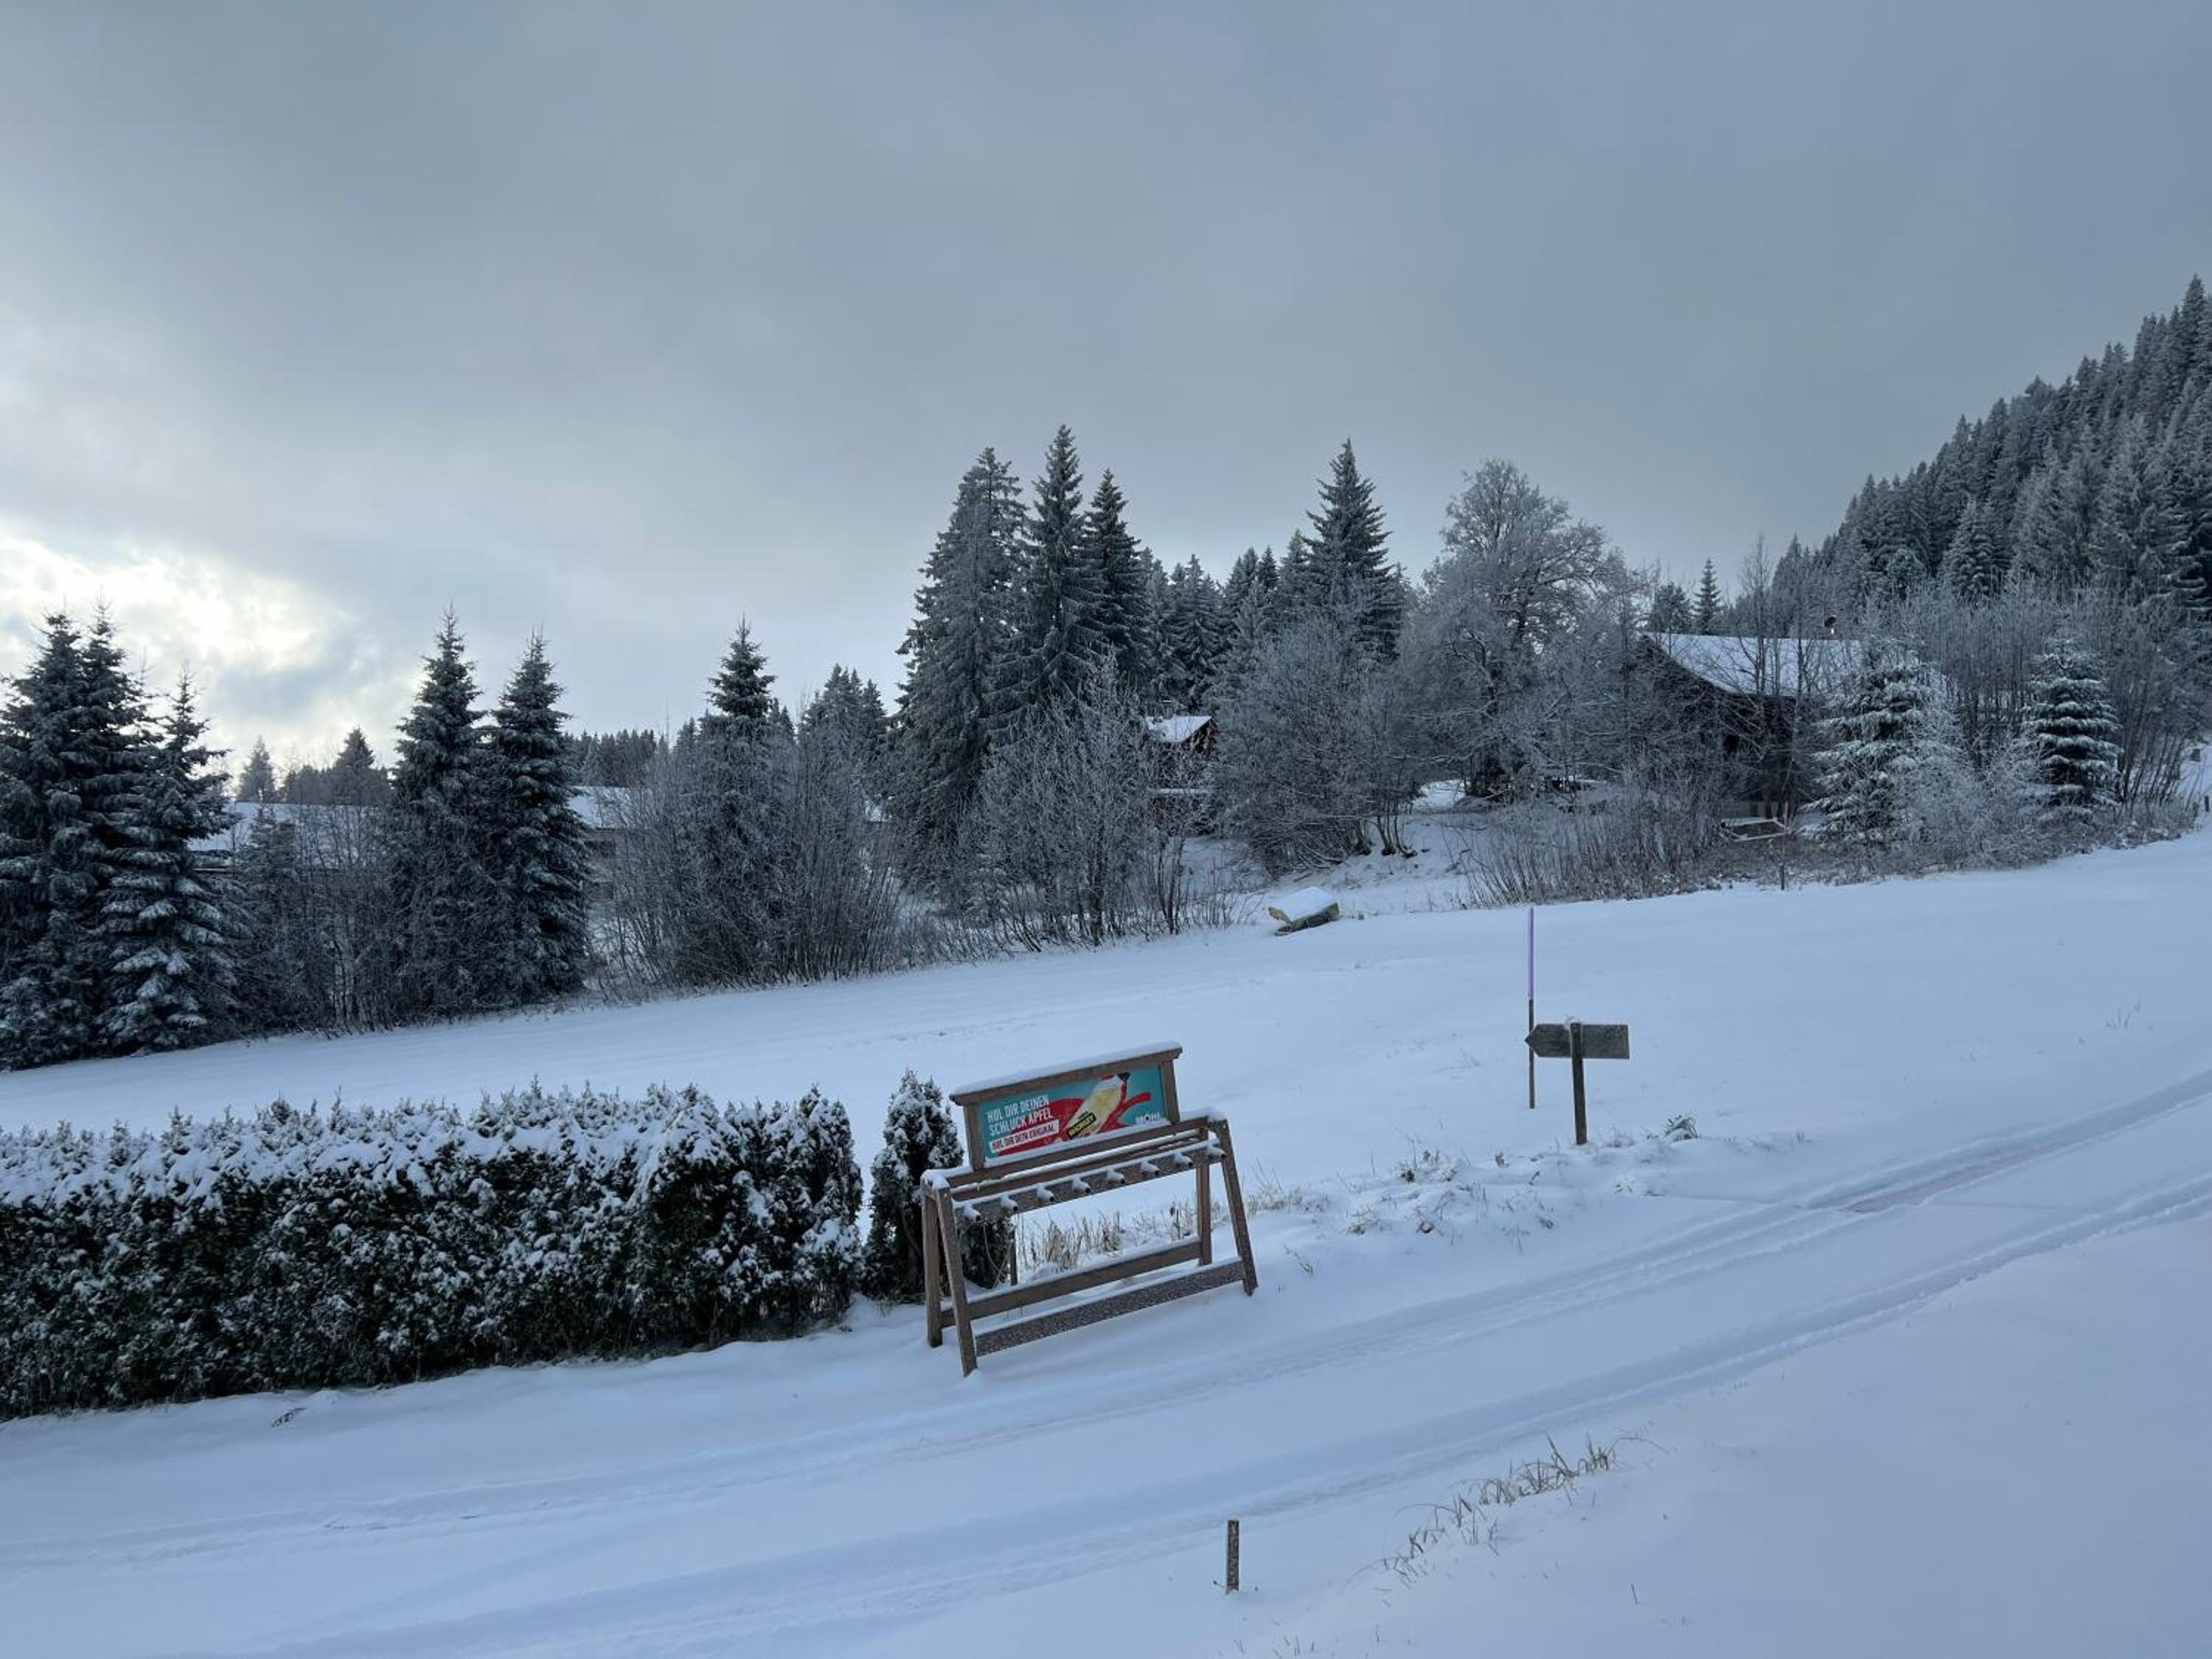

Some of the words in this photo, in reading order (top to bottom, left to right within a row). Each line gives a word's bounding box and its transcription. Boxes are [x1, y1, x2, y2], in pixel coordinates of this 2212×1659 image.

[987, 1108, 1004, 1123] HOL
[1004, 1102, 1020, 1117] DIR
[1020, 1093, 1049, 1113] DEINEN
[990, 1114, 1027, 1135] SCHLUCK
[1015, 1132, 1029, 1144] DEIN
